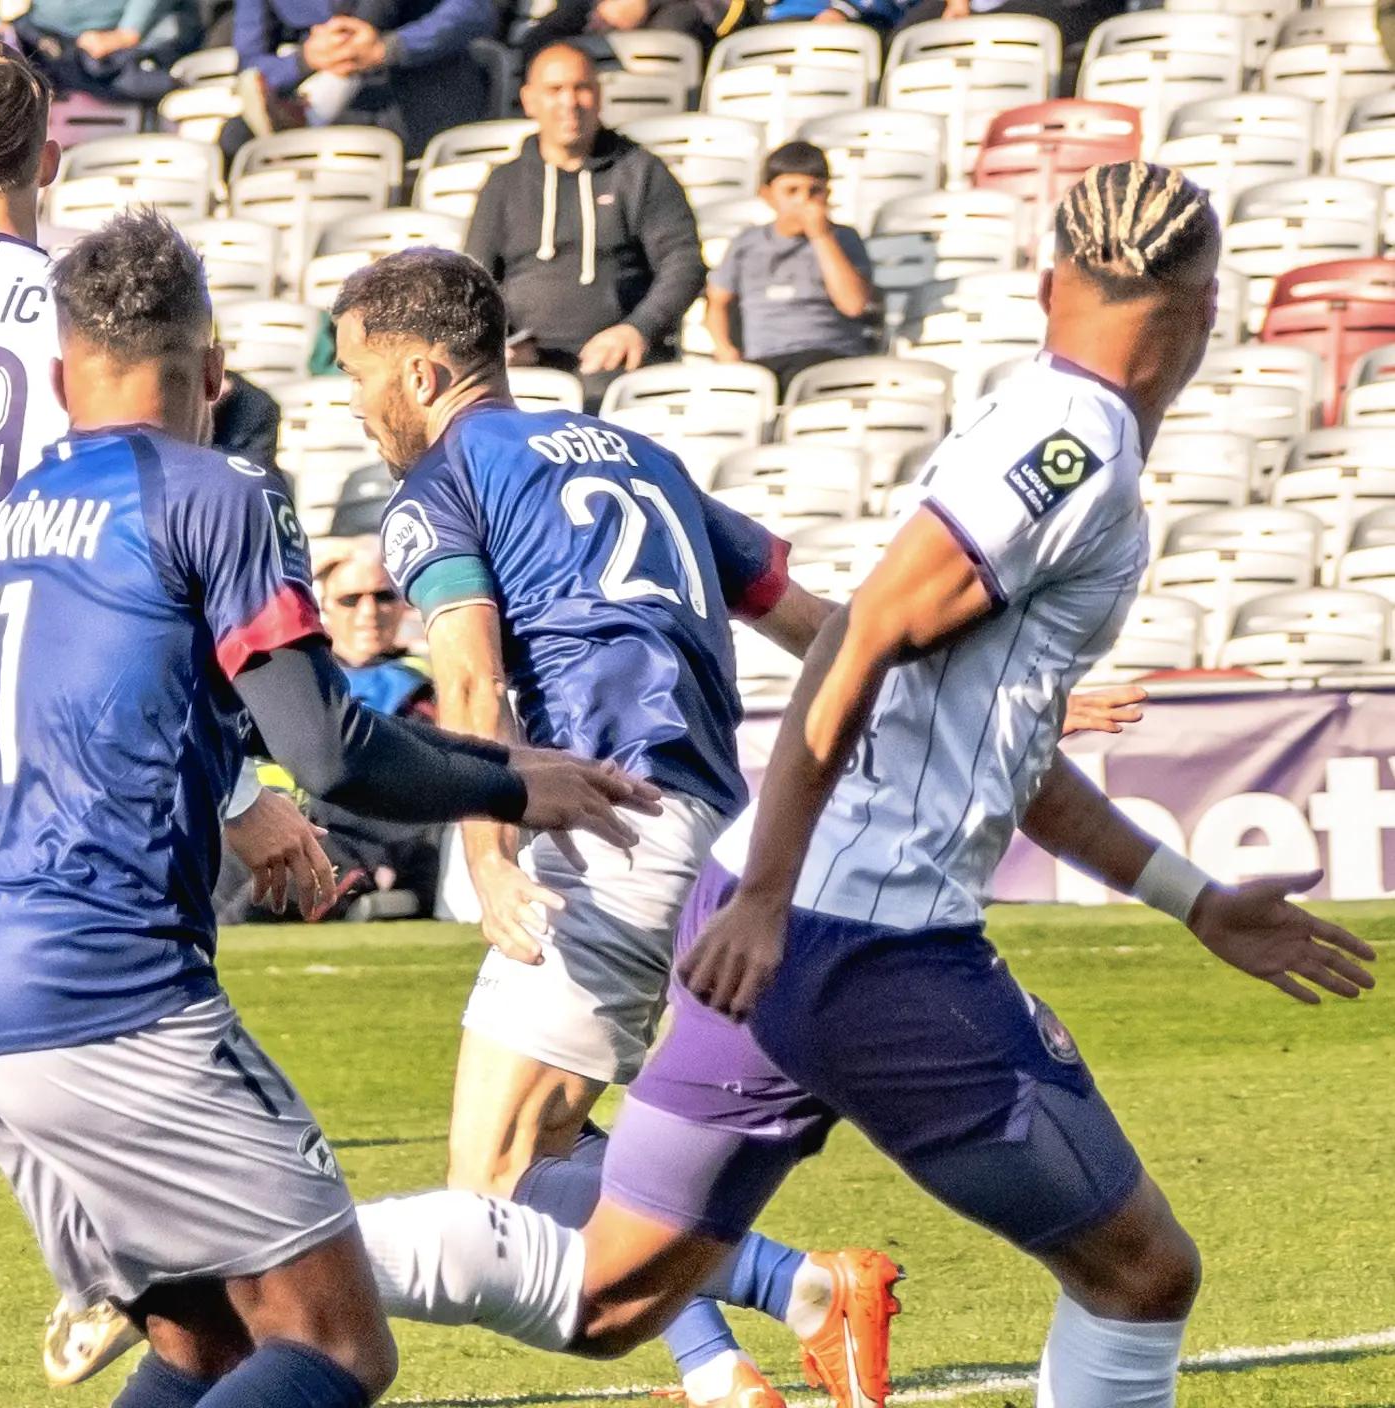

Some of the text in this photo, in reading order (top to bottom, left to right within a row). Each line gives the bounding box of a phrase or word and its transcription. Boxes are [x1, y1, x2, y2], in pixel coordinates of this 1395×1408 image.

[1009, 469, 1030, 492] Uber
[1021, 464, 1054, 502] LIGUE 1
[560, 476, 707, 619] 21
